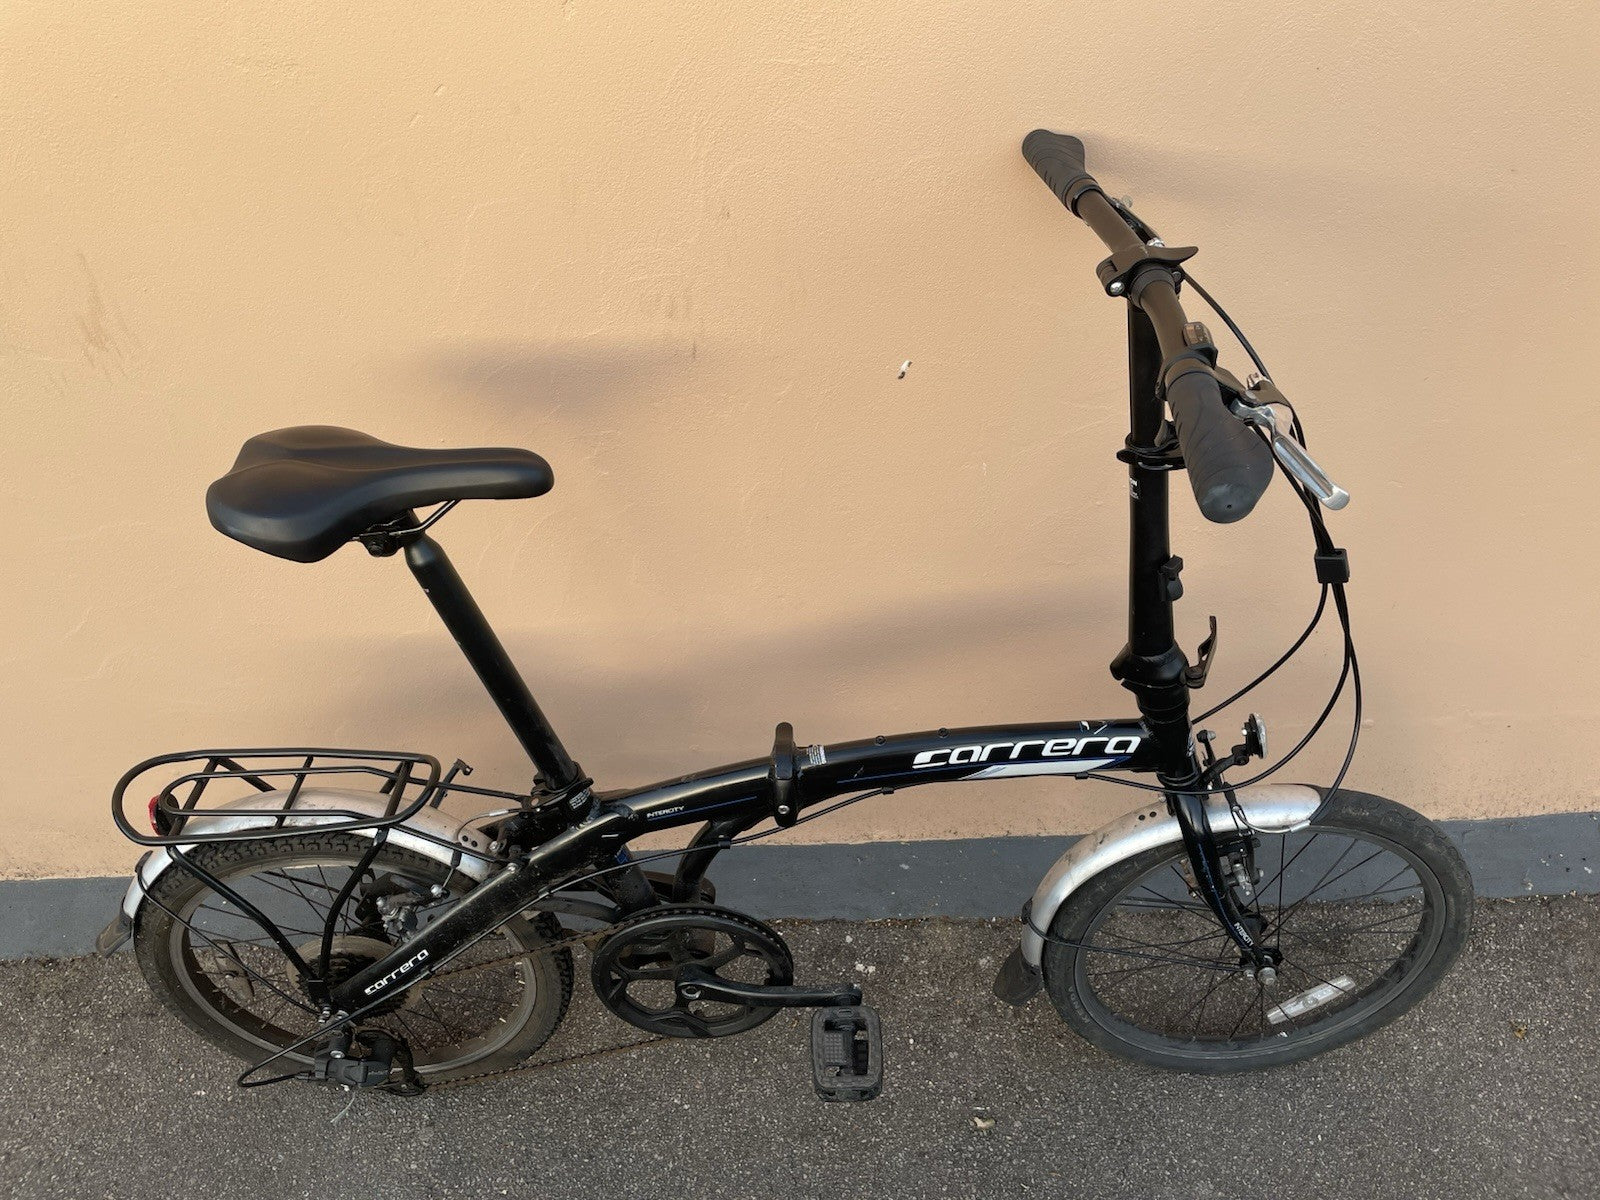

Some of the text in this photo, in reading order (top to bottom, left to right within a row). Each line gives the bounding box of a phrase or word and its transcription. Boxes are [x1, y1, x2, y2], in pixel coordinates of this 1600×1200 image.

[912, 736, 1141, 769] carrera
[646, 805, 685, 819] INTERCITY
[1234, 921, 1254, 947] INTERCITY
[364, 949, 429, 996] carrera
